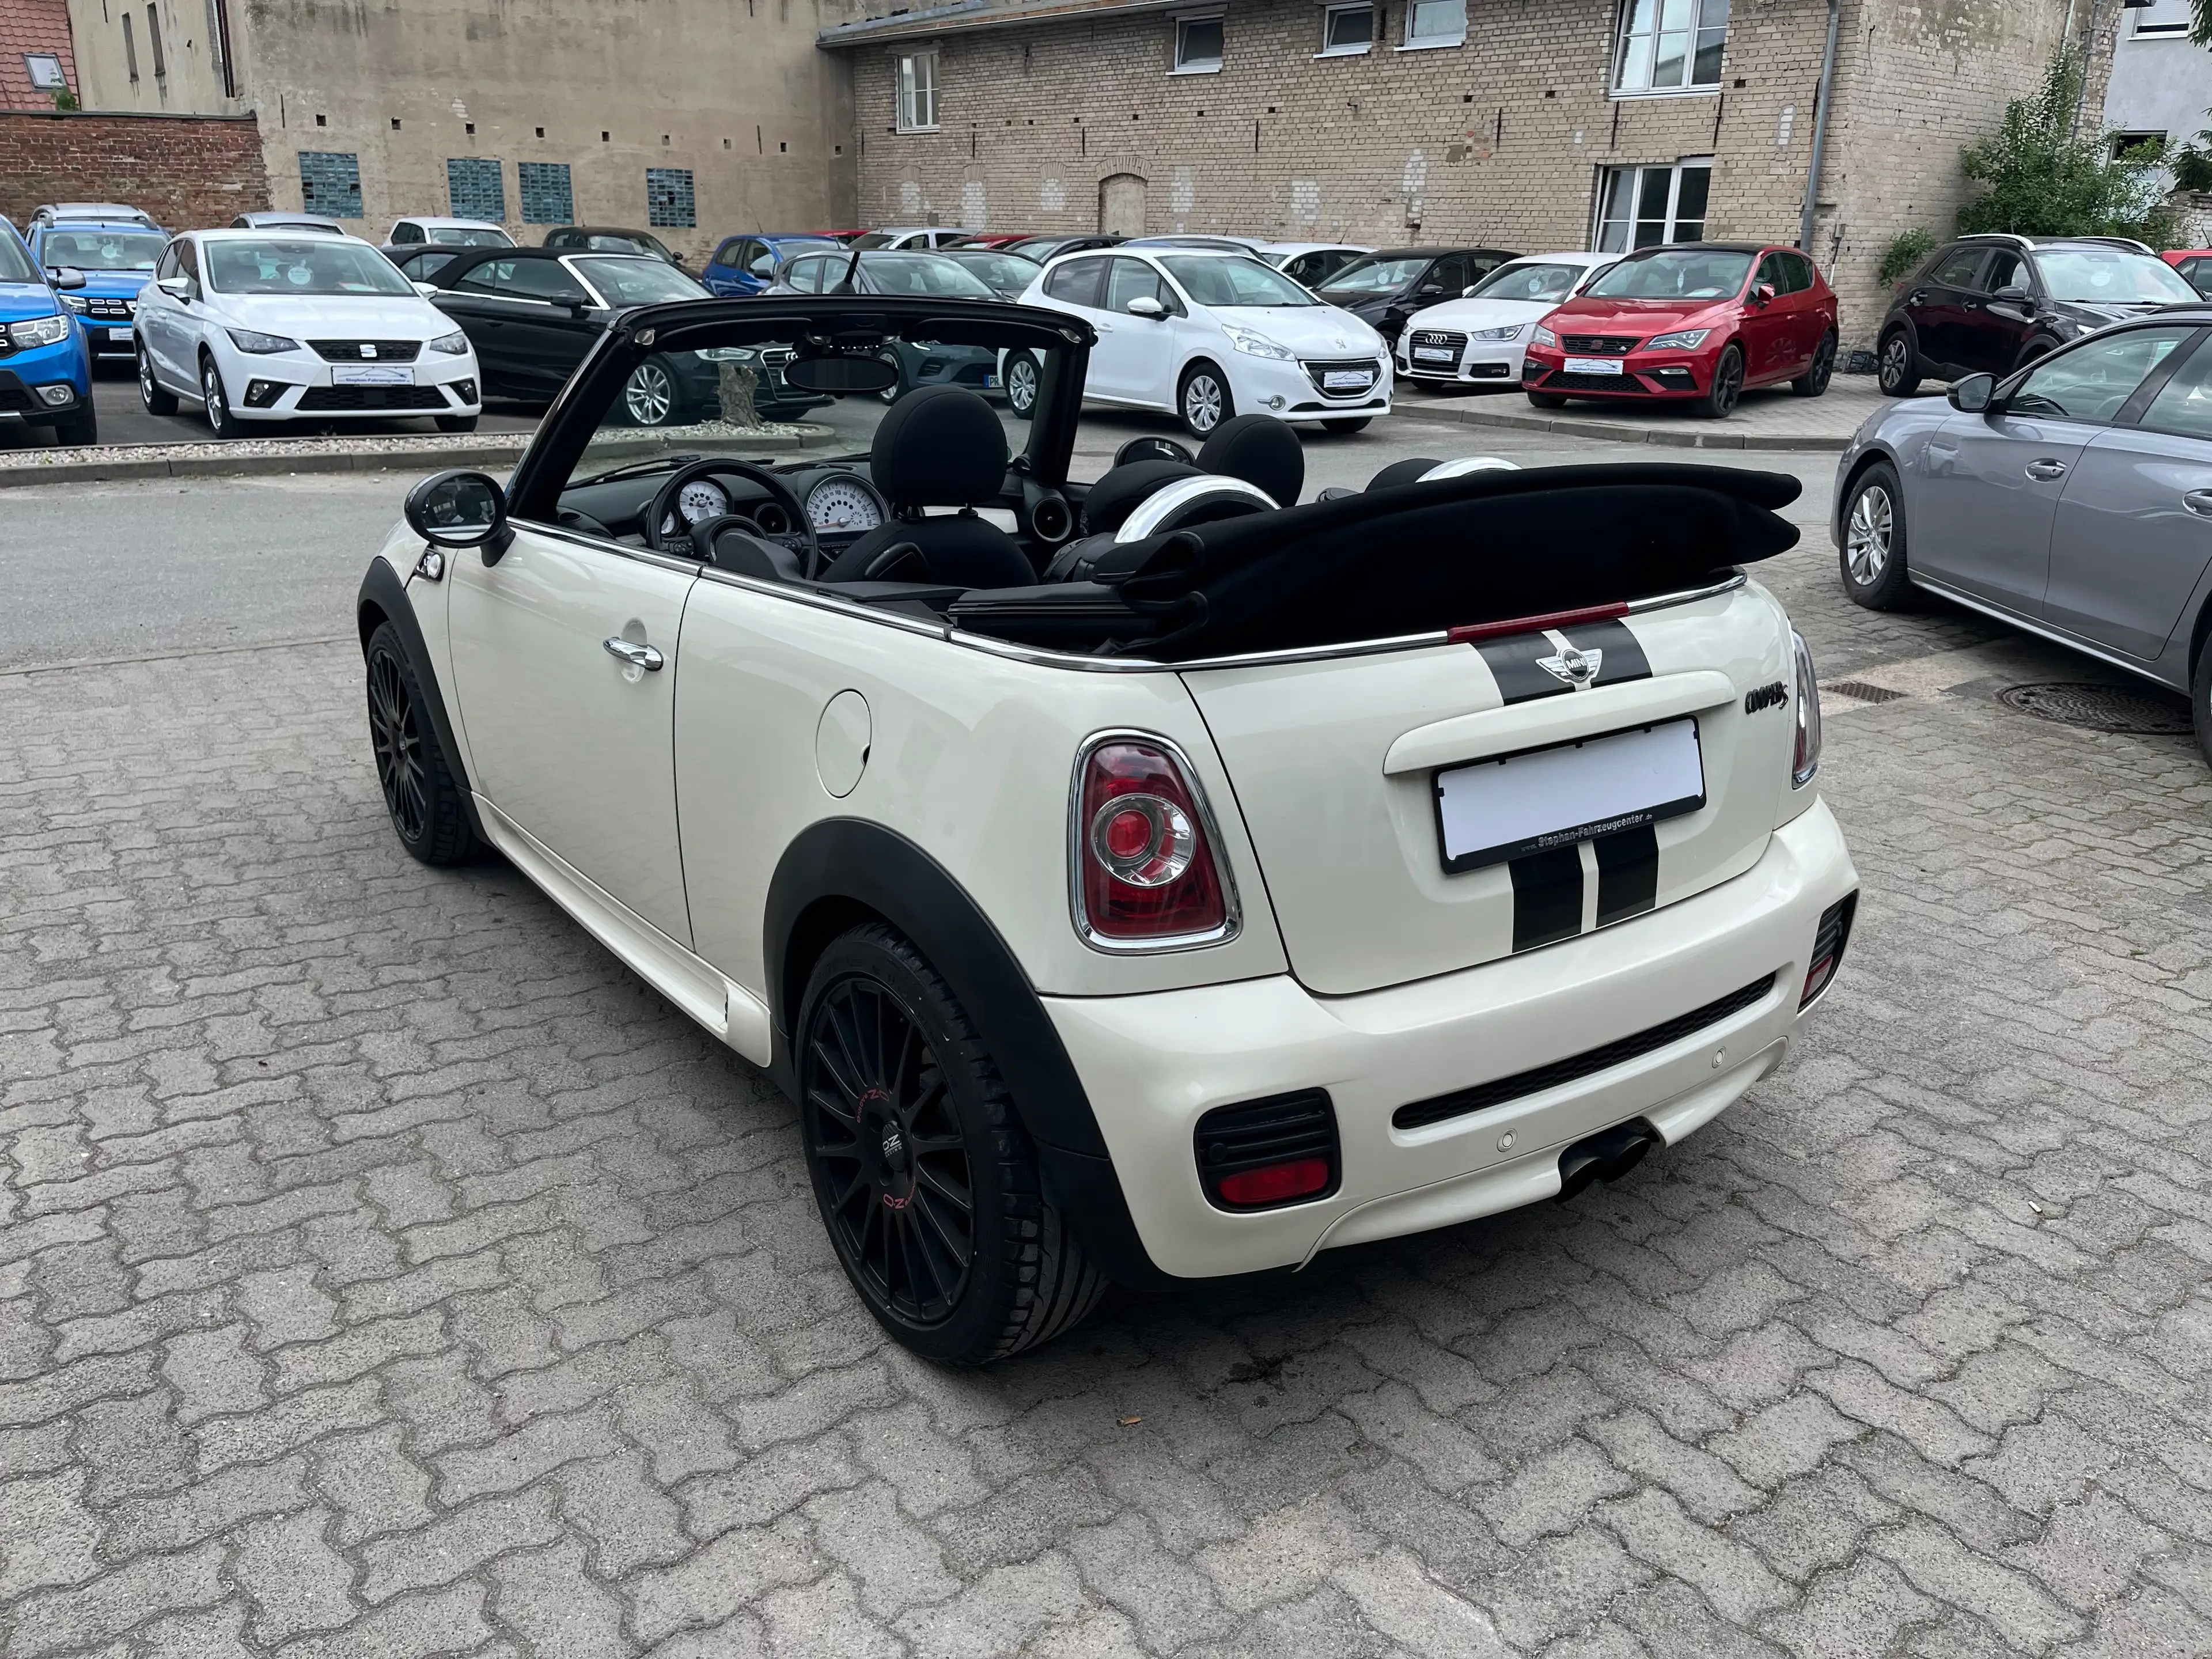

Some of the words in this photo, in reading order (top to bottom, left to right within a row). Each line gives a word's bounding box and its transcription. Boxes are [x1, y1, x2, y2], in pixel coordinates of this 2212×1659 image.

[990, 377, 999, 387] PR
[1565, 657, 1587, 669] MINI
[1744, 680, 1783, 715] COOPER
[1778, 684, 1789, 710] S
[1538, 813, 1643, 848] Stephan-Fahrzeugcenter
